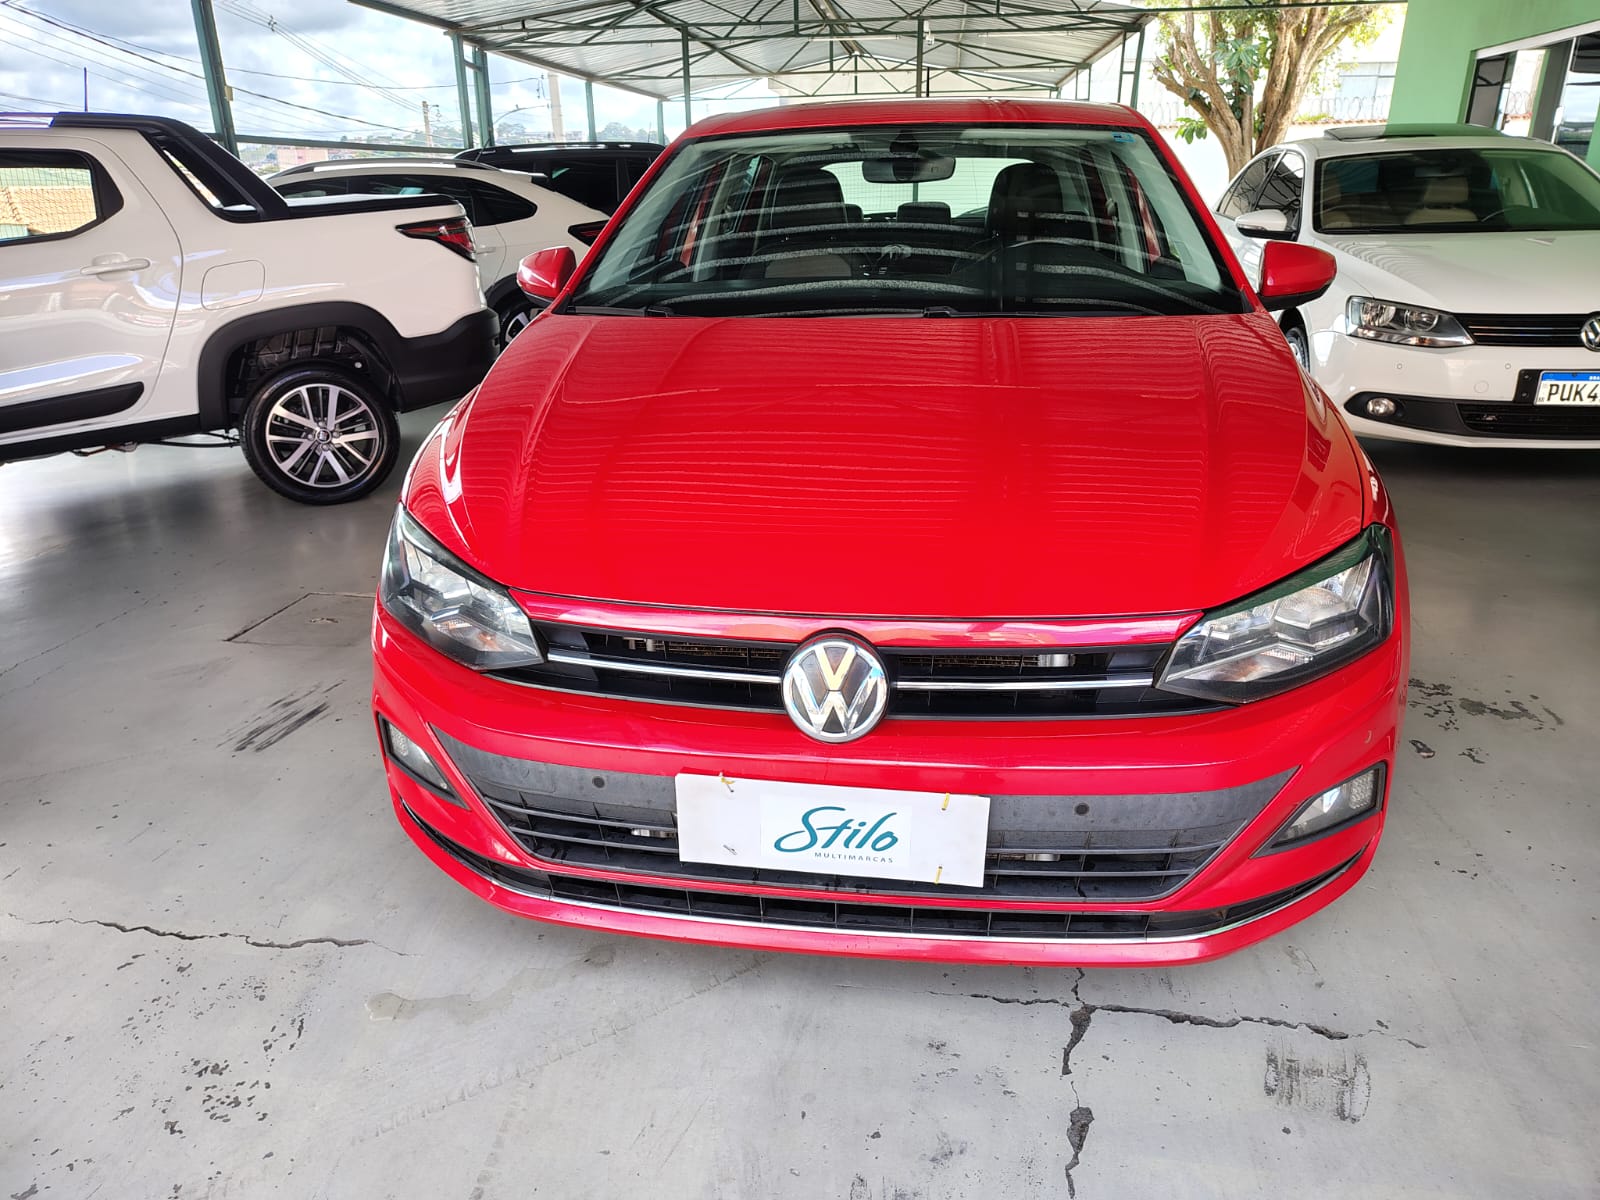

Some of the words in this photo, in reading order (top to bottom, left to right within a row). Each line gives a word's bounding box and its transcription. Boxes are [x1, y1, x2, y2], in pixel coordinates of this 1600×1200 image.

[1547, 383, 1600, 402] PUK4
[774, 806, 898, 853] Stilo
[814, 852, 893, 863] MULTIMARCAS
